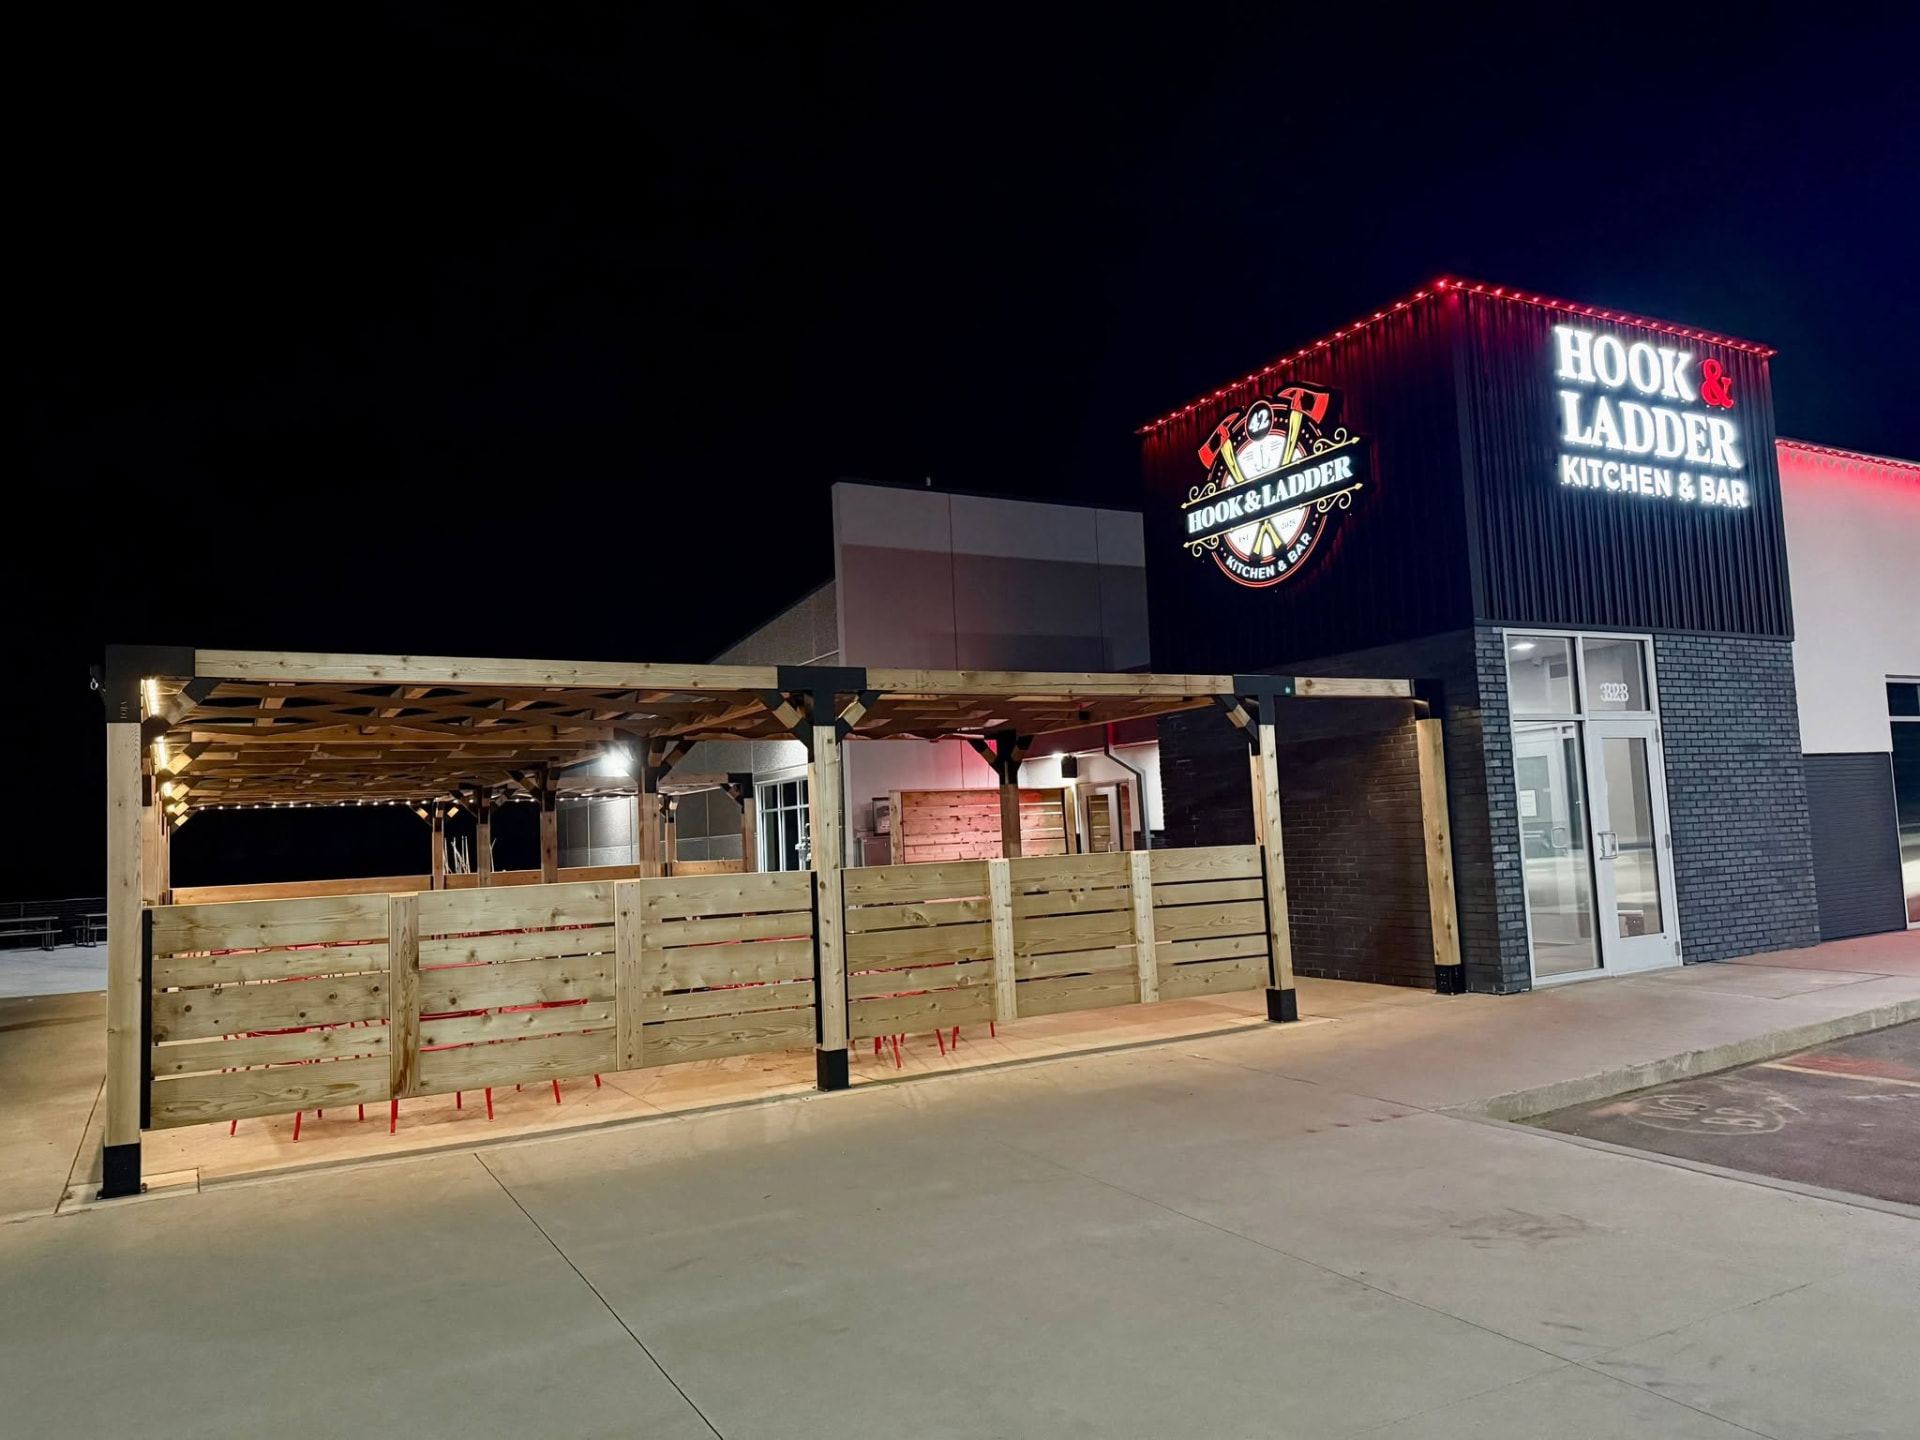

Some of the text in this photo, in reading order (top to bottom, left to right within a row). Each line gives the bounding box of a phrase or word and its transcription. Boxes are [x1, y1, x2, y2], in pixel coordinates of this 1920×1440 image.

[1555, 325, 1736, 409] HOOK &
[1249, 409, 1270, 432] 42
[1560, 390, 1745, 469] LADDER
[1187, 494, 1244, 534] HOOK
[1263, 456, 1353, 507] LADDER
[1561, 454, 1750, 508] KITCHEN & BAR
[1226, 532, 1313, 579] KITCHEN & BAR
